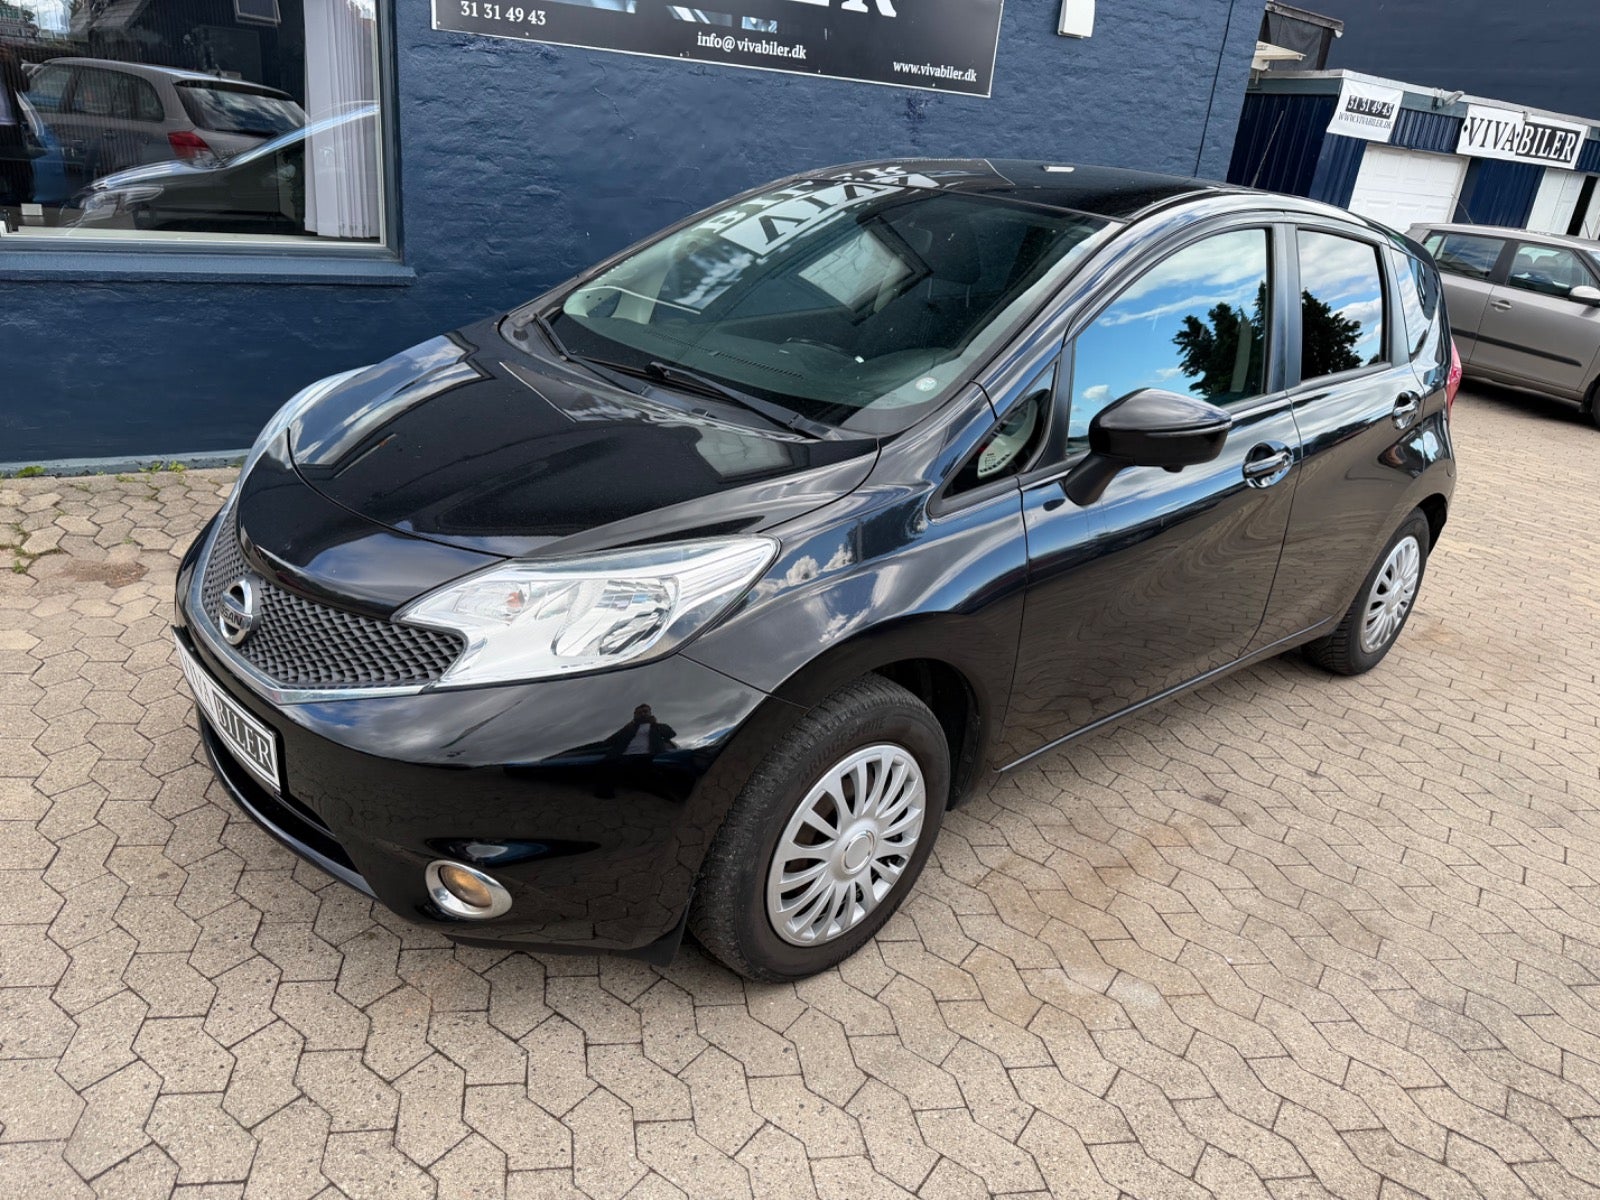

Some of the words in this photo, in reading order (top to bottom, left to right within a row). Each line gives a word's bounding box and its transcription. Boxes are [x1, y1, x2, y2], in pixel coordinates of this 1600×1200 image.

[460, 1, 477, 17] 31
[484, 4, 501, 20] 31
[505, 7, 524, 22] 49
[527, 10, 547, 26] 43
[893, 60, 977, 82] www.vivabiler.dk
[1468, 116, 1516, 152] VIVA
[1517, 125, 1577, 161] BILER
[215, 698, 275, 775] BILER
